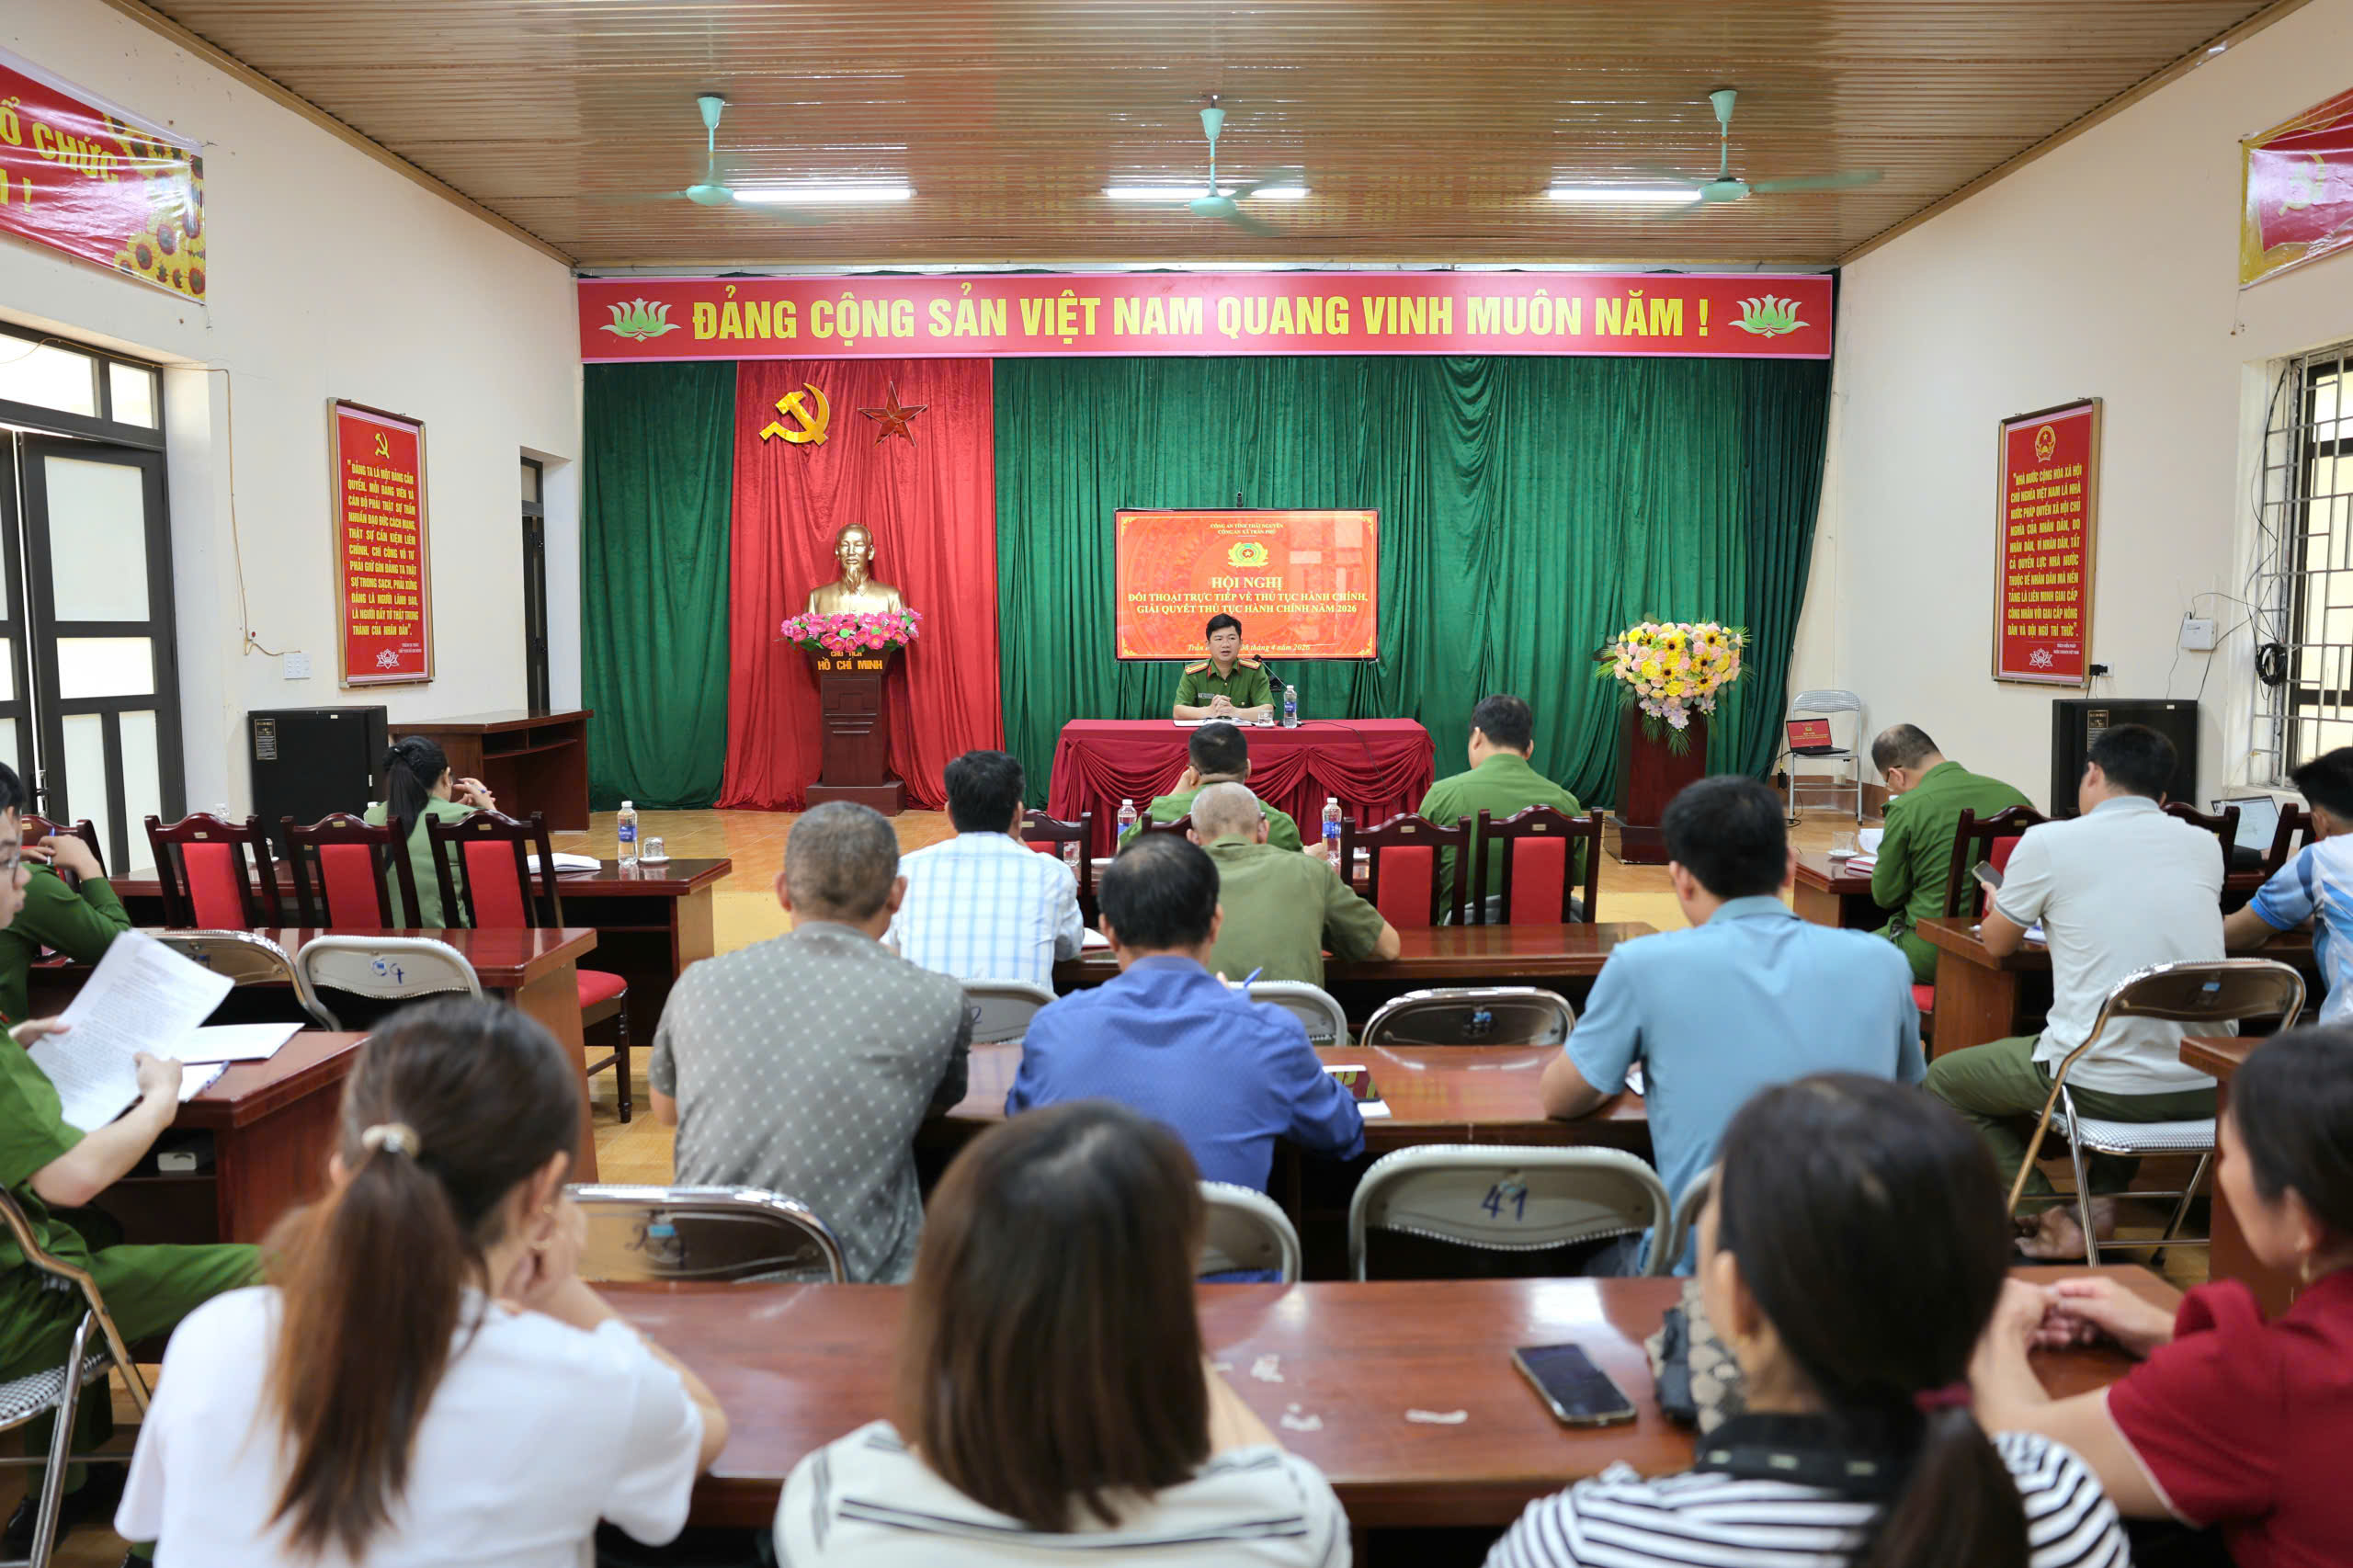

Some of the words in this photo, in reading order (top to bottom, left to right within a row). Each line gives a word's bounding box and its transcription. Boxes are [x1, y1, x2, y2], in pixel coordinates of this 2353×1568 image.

[0, 96, 22, 146] Ổ
[32, 122, 119, 186] CHỨC
[692, 285, 797, 340] ĐẢNG
[810, 291, 914, 347] CỘNG
[928, 282, 1007, 337] SẢN
[1019, 289, 1101, 345] VIỆT
[1113, 297, 1203, 336] NAM
[1216, 295, 1349, 339] QUANG
[1361, 296, 1452, 335] VINH
[1466, 290, 1582, 336] MUÔN
[1595, 290, 1683, 336] NĂM
[1698, 297, 1710, 336] !
[1211, 575, 1239, 592] HỘI
[1244, 576, 1283, 591] NGHỊ
[1128, 591, 1147, 602] ĐỐI
[1149, 593, 1182, 603] THOẠI
[1183, 592, 1212, 603] TRỰC
[1213, 588, 1237, 602] TIẾP
[1239, 591, 1252, 602] VỀ
[1255, 591, 1276, 602] THỦ
[1278, 593, 1298, 603] TỤC
[1301, 591, 1330, 602] HÀNH
[1332, 591, 1369, 602] CHÍNH,
[1161, 603, 1196, 615] QUYẾT
[1198, 603, 1220, 613] THỦ
[1222, 605, 1242, 615] TỤC
[1245, 603, 1274, 613] HÀNH
[1276, 603, 1310, 613] CHÍNH
[1312, 603, 1335, 613] NĂM
[1337, 605, 1358, 613] 2026
[817, 656, 832, 671] HỒ
[836, 657, 853, 670] CHÍ
[857, 660, 883, 670] MINH
[1480, 1185, 1529, 1221] 41
